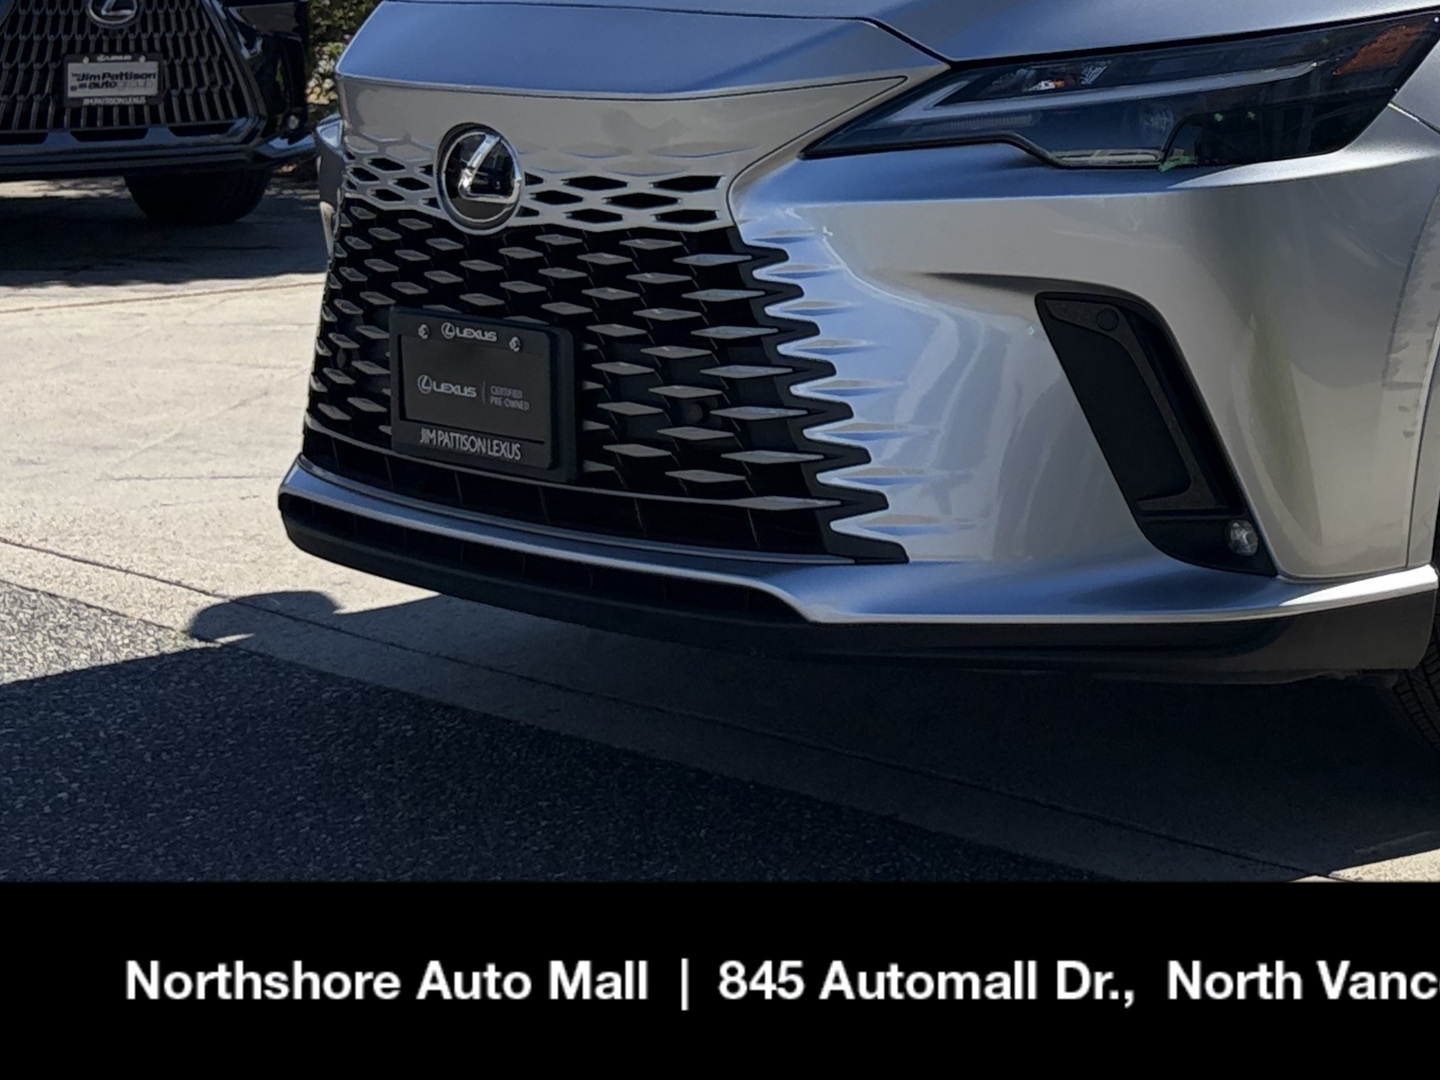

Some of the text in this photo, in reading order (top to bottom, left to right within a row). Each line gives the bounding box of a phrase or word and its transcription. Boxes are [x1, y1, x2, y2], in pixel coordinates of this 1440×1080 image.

[455, 327, 497, 343] LEXUS
[432, 380, 477, 398] LEXUS
[419, 428, 521, 461] JIM PATTISON LEXUS
